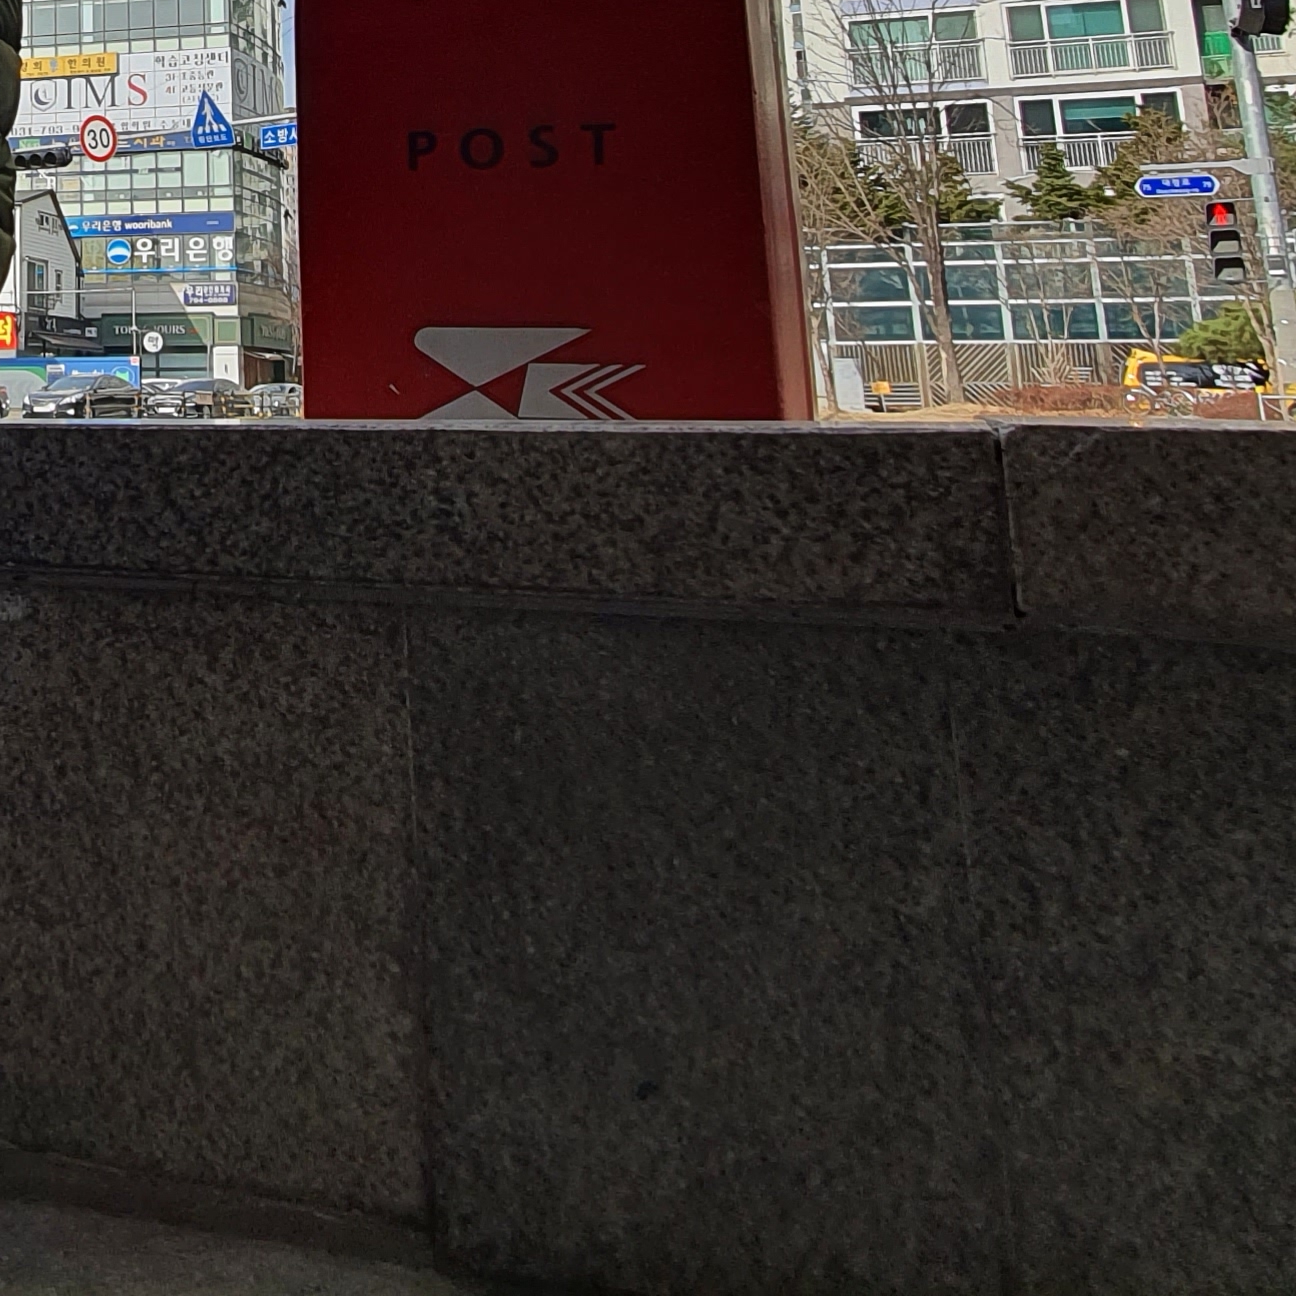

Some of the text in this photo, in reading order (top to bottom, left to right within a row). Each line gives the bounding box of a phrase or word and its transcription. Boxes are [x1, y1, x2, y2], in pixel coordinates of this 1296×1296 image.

[87, 128, 110, 150] 30
[407, 123, 617, 172] POST
[82, 219, 173, 233] 우리은행 wooribank
[134, 236, 234, 264] 우리은행
